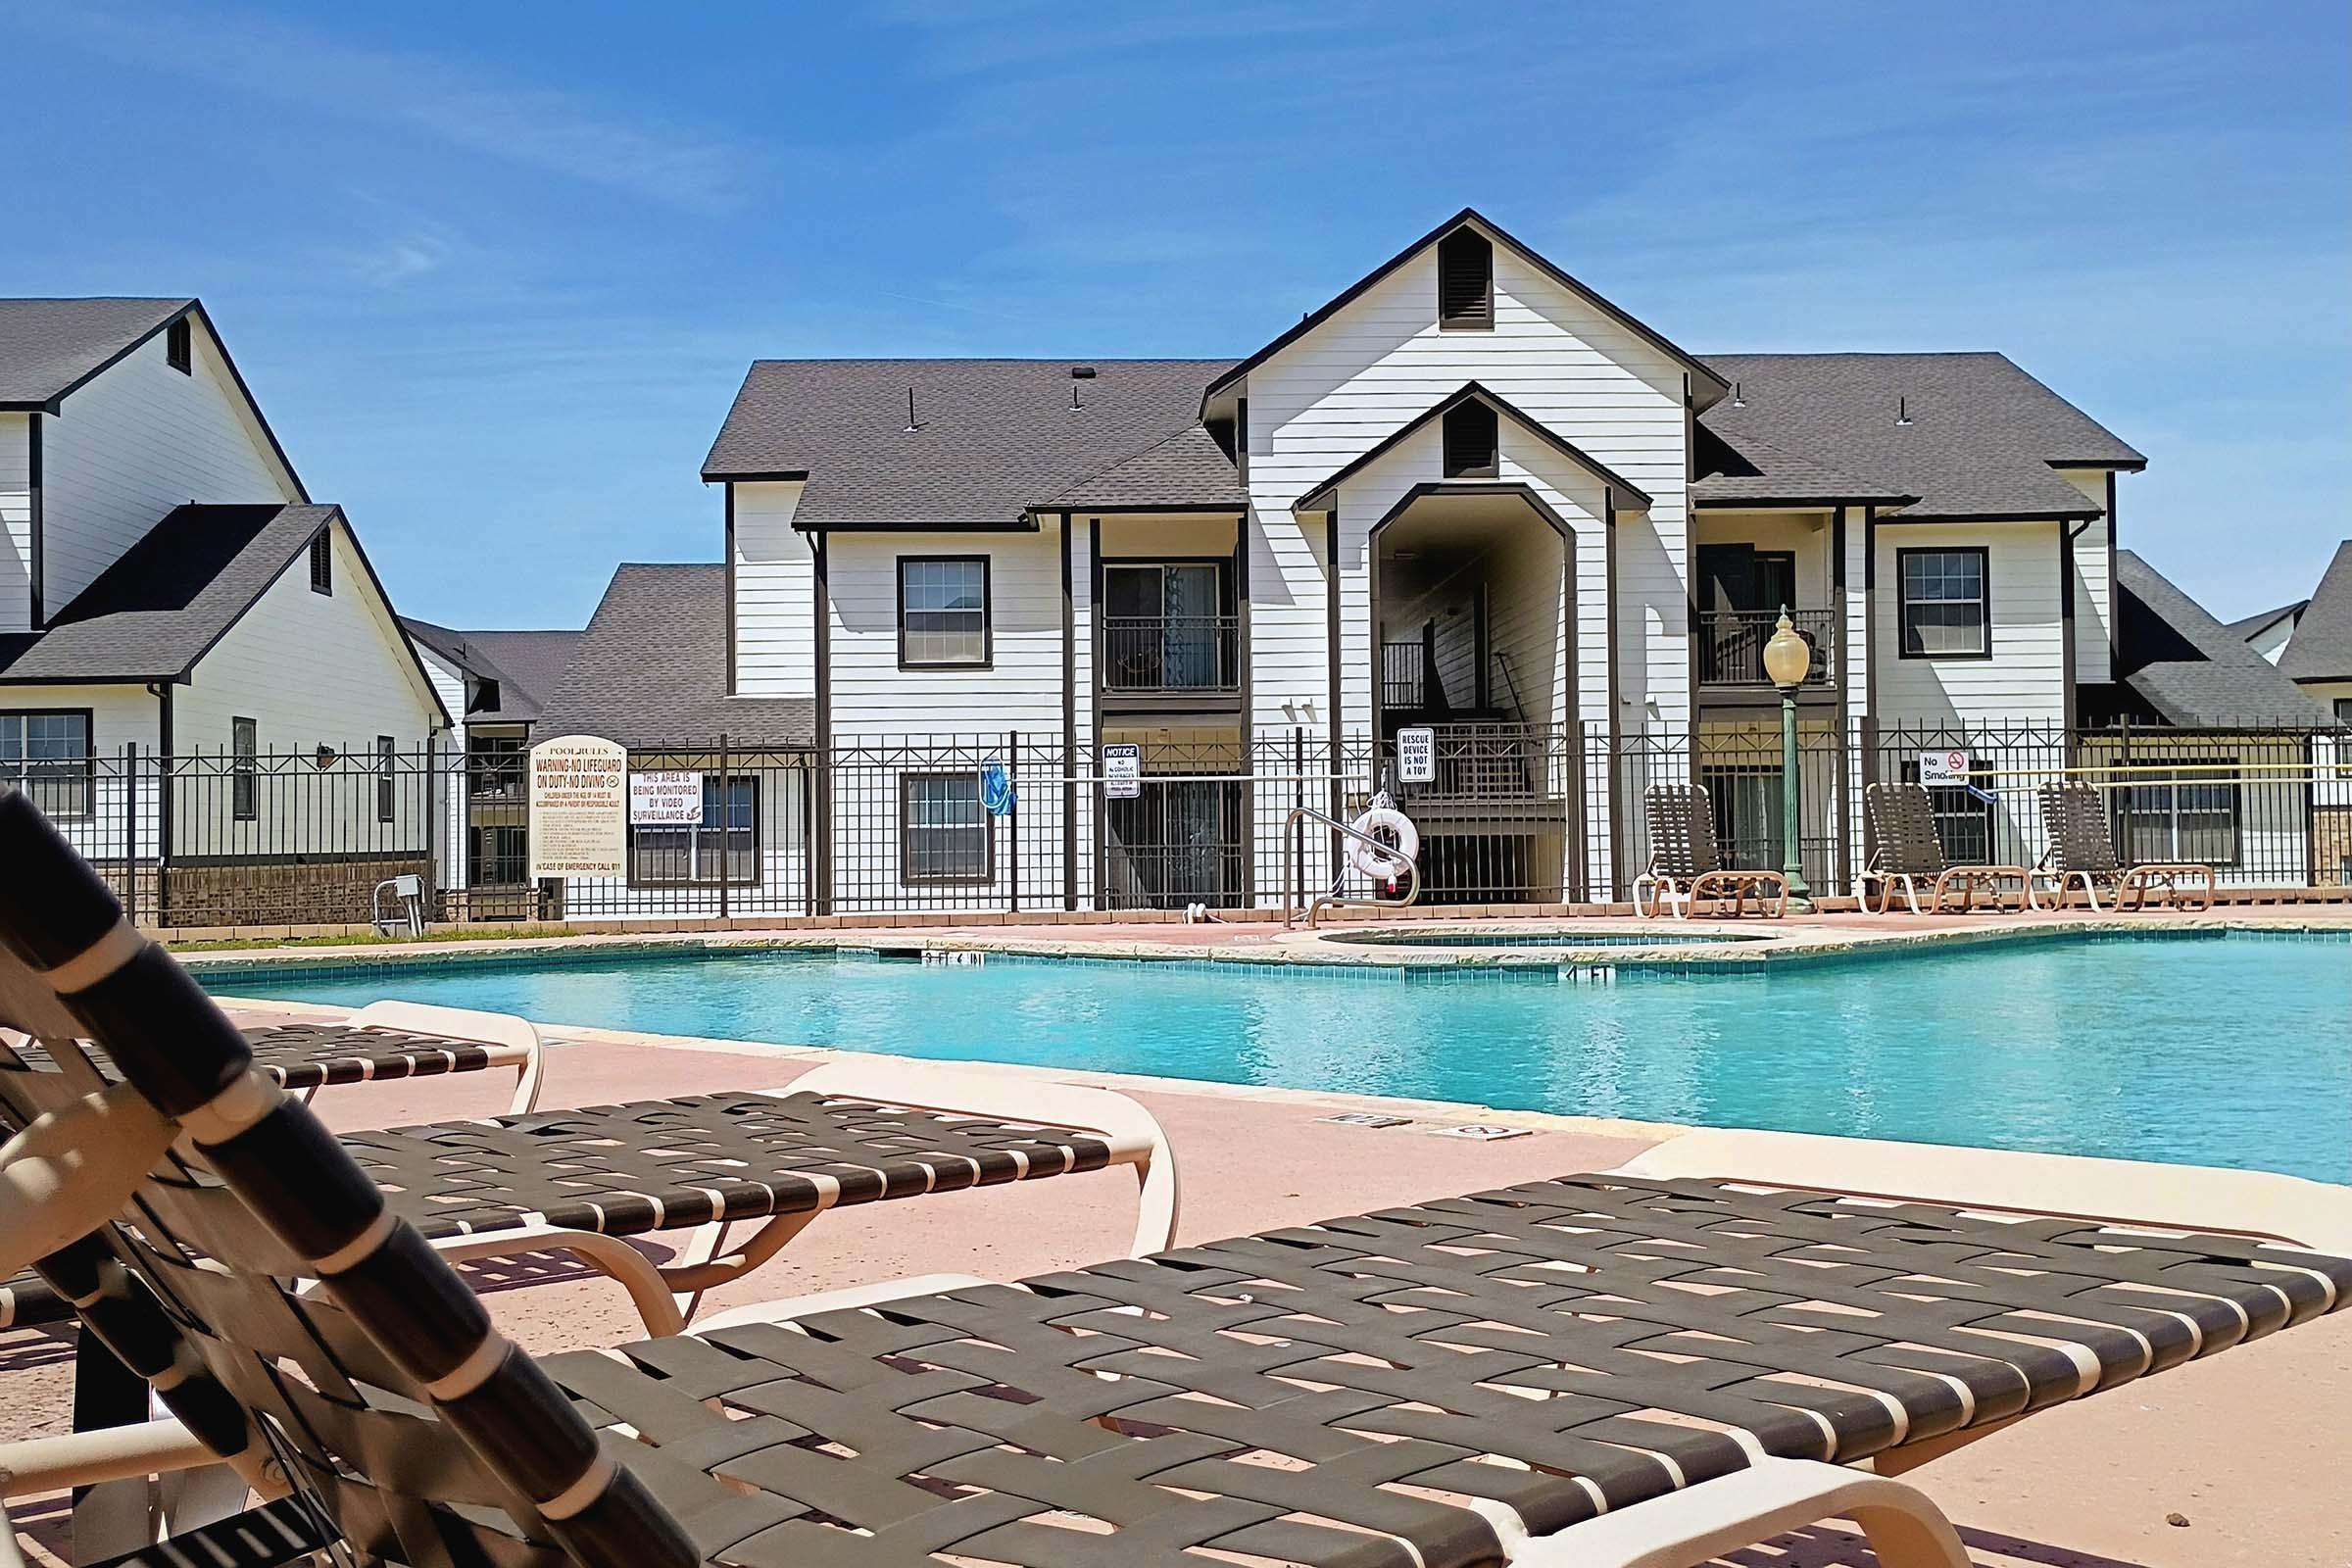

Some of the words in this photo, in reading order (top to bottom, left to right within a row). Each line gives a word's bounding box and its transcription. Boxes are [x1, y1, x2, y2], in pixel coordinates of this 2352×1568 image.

[1402, 734, 1430, 744] RESCUE
[550, 747, 580, 756] POOL
[580, 747, 609, 756] RULES
[1106, 748, 1136, 758] NOTICE
[1403, 745, 1428, 755] DEVICE
[1404, 756, 1411, 764] IS
[1413, 756, 1428, 764] NOT
[1924, 757, 1937, 766] No
[535, 759, 581, 772] WARNING-NO
[583, 759, 622, 772] LIFEGUARD
[1406, 766, 1411, 775] A
[1413, 766, 1427, 775] TOY
[537, 774, 548, 789] ON
[549, 774, 579, 789] DUTY-NO
[581, 774, 605, 789] DIVING
[643, 772, 659, 783] THIS
[661, 772, 681, 783] AREA
[683, 772, 690, 783] IS
[633, 785, 655, 796] BEING
[657, 785, 698, 796] MONITORED
[650, 798, 659, 808] BY
[662, 798, 684, 808] VIDEO
[633, 810, 684, 820] SURVEILLANCE
[542, 862, 556, 871] CASE
[558, 862, 564, 871] OF
[564, 862, 597, 871] EMERGENCY
[598, 862, 611, 871] CALL
[1591, 964, 1610, 985] FT
